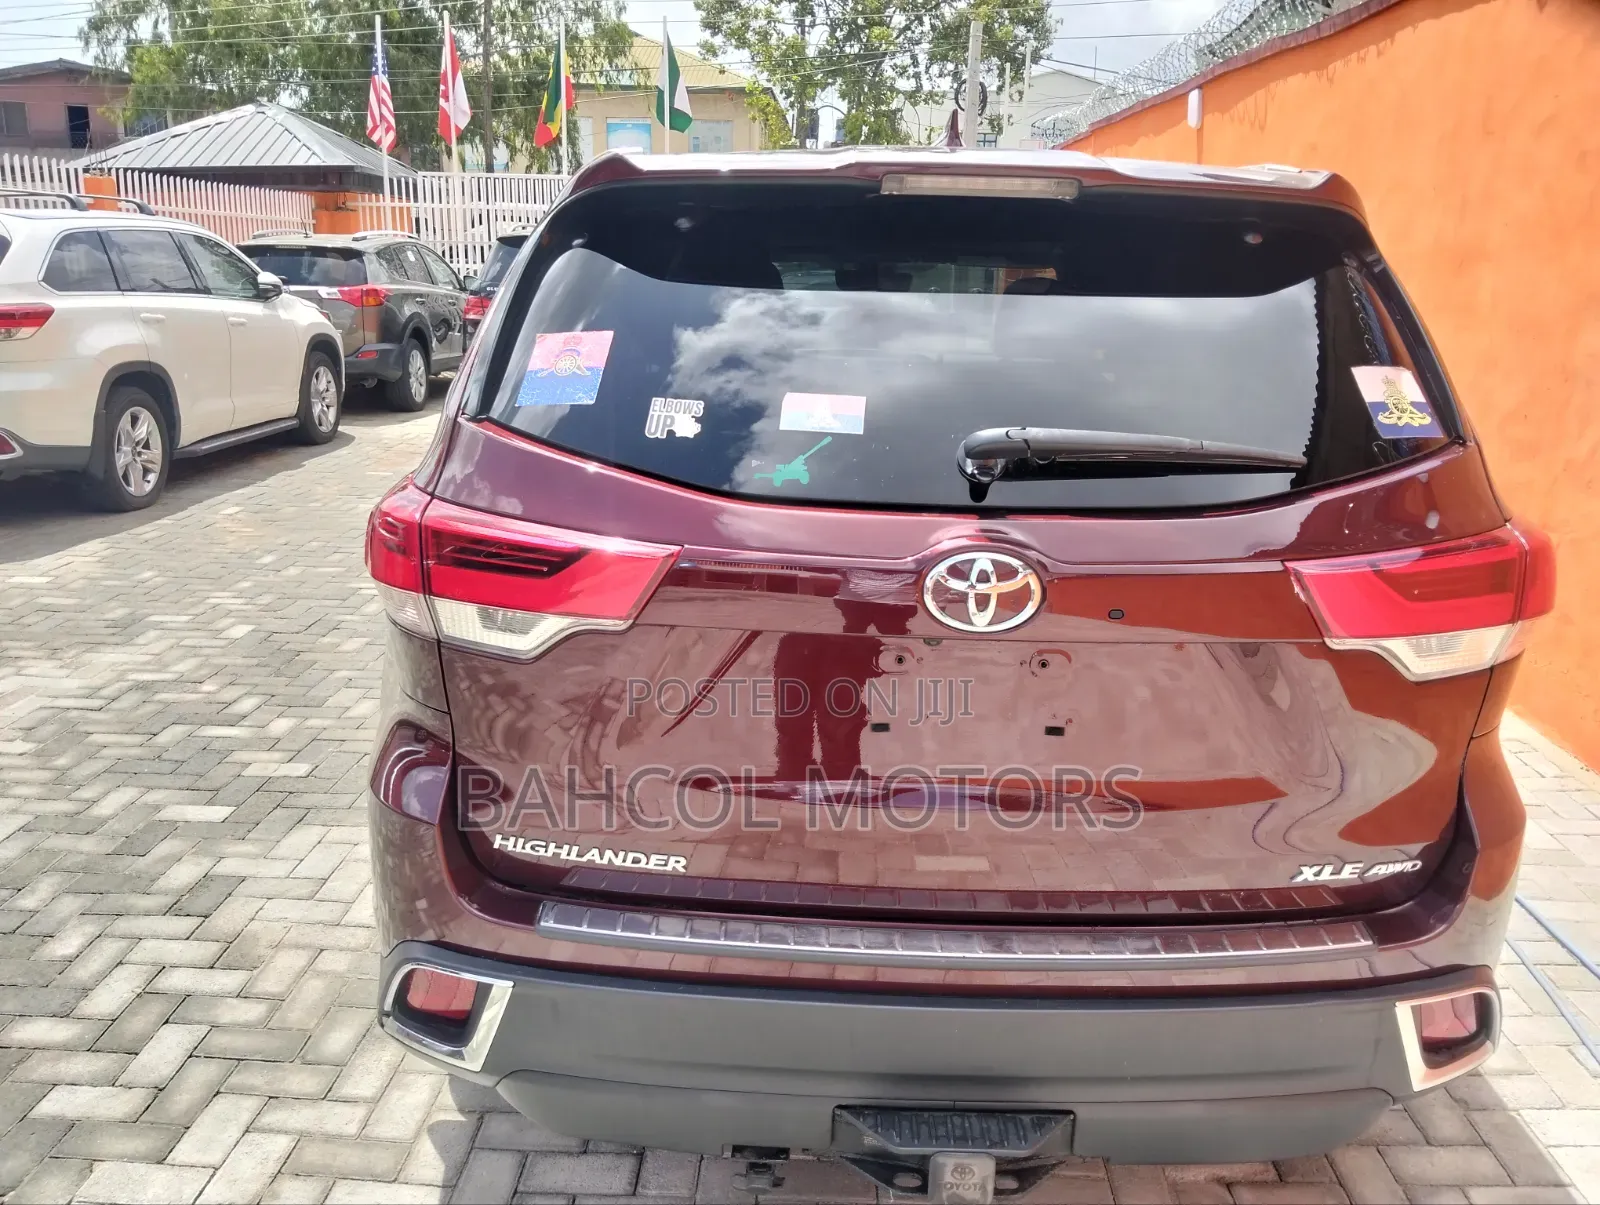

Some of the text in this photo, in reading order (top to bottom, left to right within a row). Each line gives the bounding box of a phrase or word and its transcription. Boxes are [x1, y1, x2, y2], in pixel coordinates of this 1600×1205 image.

[651, 399, 703, 416] ELBOWS
[646, 413, 676, 437] UP
[493, 834, 688, 873] HIGHLANDER
[1291, 859, 1423, 883] XLE AWD
